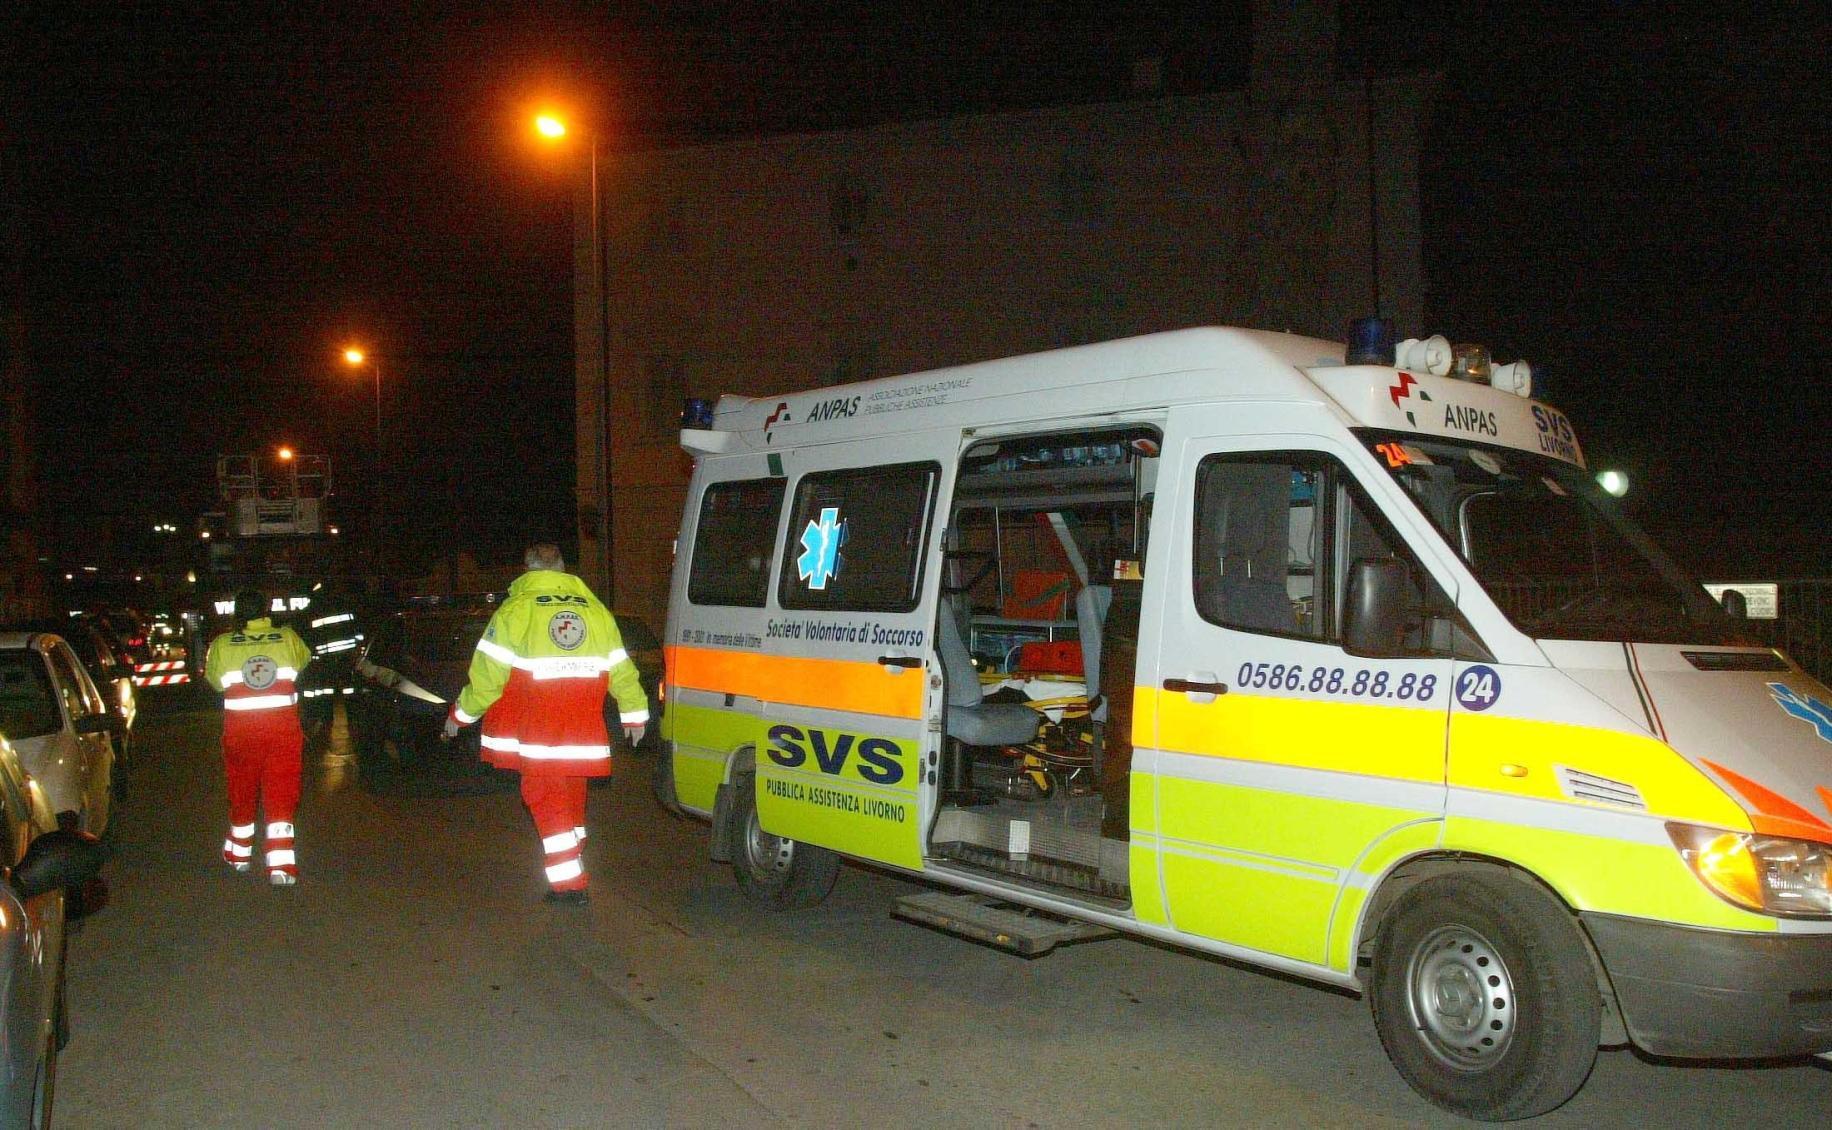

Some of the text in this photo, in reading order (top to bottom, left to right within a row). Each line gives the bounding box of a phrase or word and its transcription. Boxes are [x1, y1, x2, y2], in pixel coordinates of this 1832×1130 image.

[806, 396, 862, 423] ANPAS
[1444, 403, 1498, 437] ANPAS
[1531, 405, 1573, 443] SVS
[805, 620, 857, 644] Volontaria
[858, 621, 869, 645] di
[871, 622, 924, 647] Soccorso
[1237, 662, 1437, 702] 0586.88.88.88
[1460, 672, 1494, 704] 24
[767, 724, 904, 785] SVS
[766, 779, 905, 823] PUBBLICA ASSISTENZA LIVORNO
